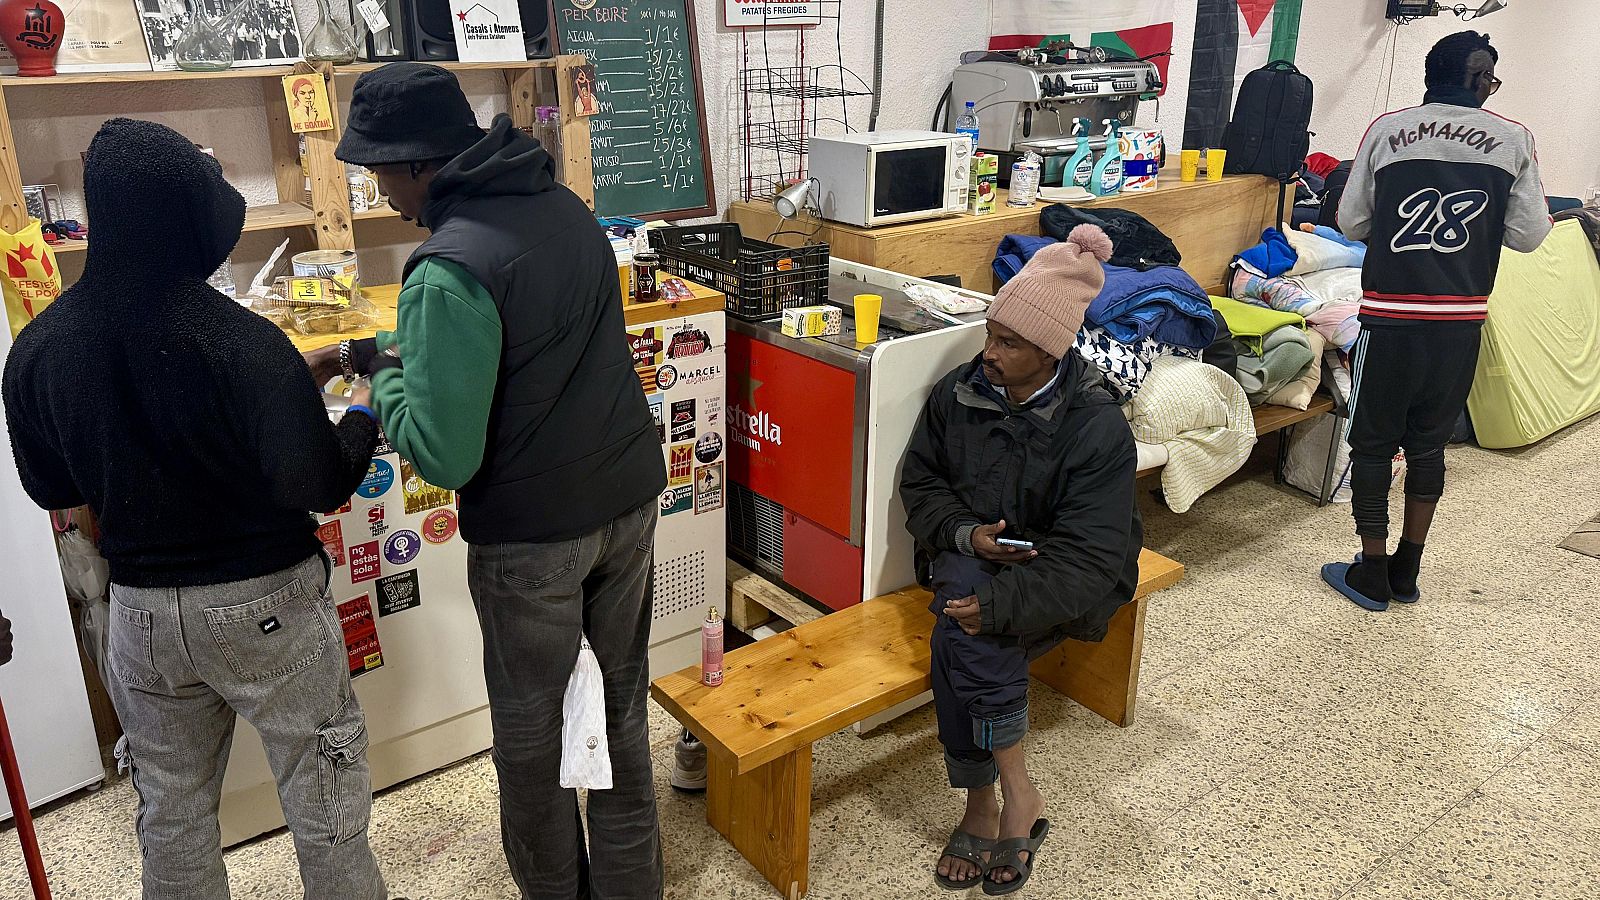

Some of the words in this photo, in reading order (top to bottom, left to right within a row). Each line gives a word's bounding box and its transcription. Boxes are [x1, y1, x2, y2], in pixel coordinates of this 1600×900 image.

[561, 8, 592, 23] PER
[593, 6, 629, 23] BEURE
[742, 7, 772, 15] PATATES
[773, 6, 807, 14] FREGIDES
[465, 23, 489, 34] Casals
[490, 24, 494, 33] i
[493, 23, 520, 34] Ateneus
[567, 29, 595, 43] AIGUA
[294, 121, 302, 130] НЕ
[591, 136, 615, 150] ERMUT
[1388, 121, 1503, 154] McMAHON
[591, 150, 620, 168] NFUSIÓ
[1390, 187, 1489, 253] 28
[688, 264, 713, 281] PILLIN
[18, 279, 55, 288] FESTES
[679, 365, 721, 380] MARCEL
[726, 403, 782, 446] strella
[730, 426, 761, 453] Damm
[351, 546, 365, 556] no
[352, 553, 378, 566] estàs
[353, 564, 373, 575] sola
